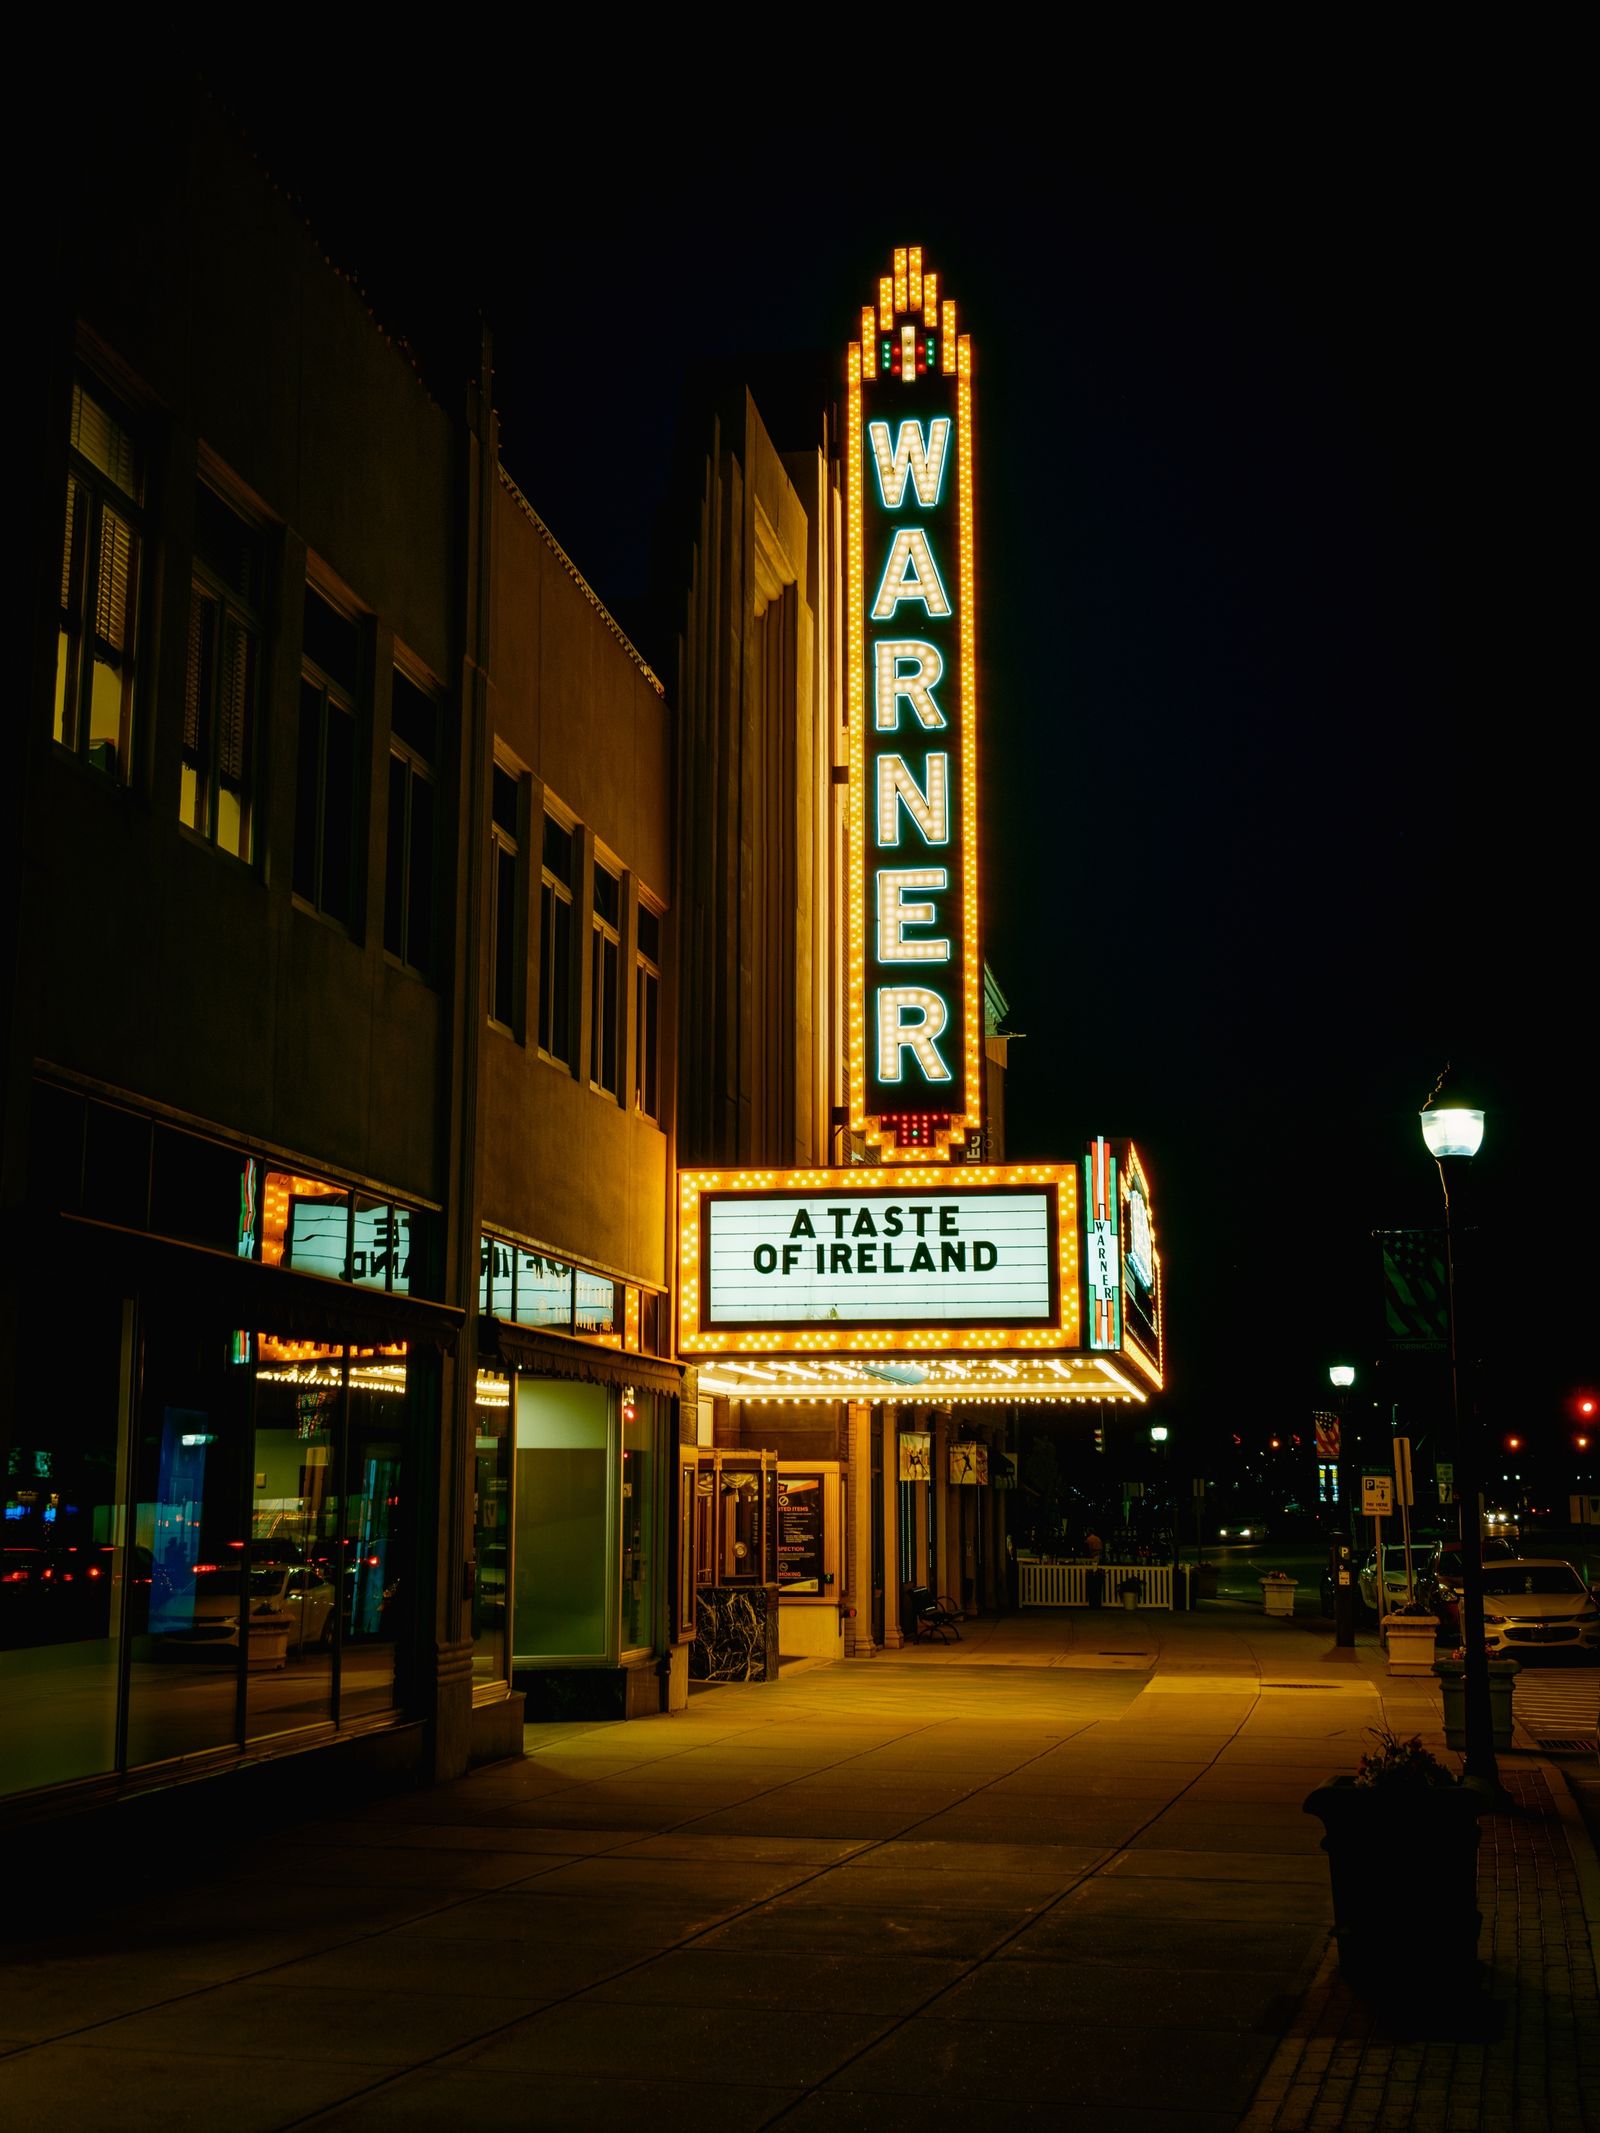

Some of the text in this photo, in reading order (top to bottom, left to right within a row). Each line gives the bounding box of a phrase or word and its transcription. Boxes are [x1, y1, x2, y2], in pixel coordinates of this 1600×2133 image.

[869, 419, 951, 1081] WARNER
[789, 1206, 959, 1239] A TASTE
[753, 1240, 998, 1275] OF IRELAND
[1096, 1221, 1112, 1299] WARNER
